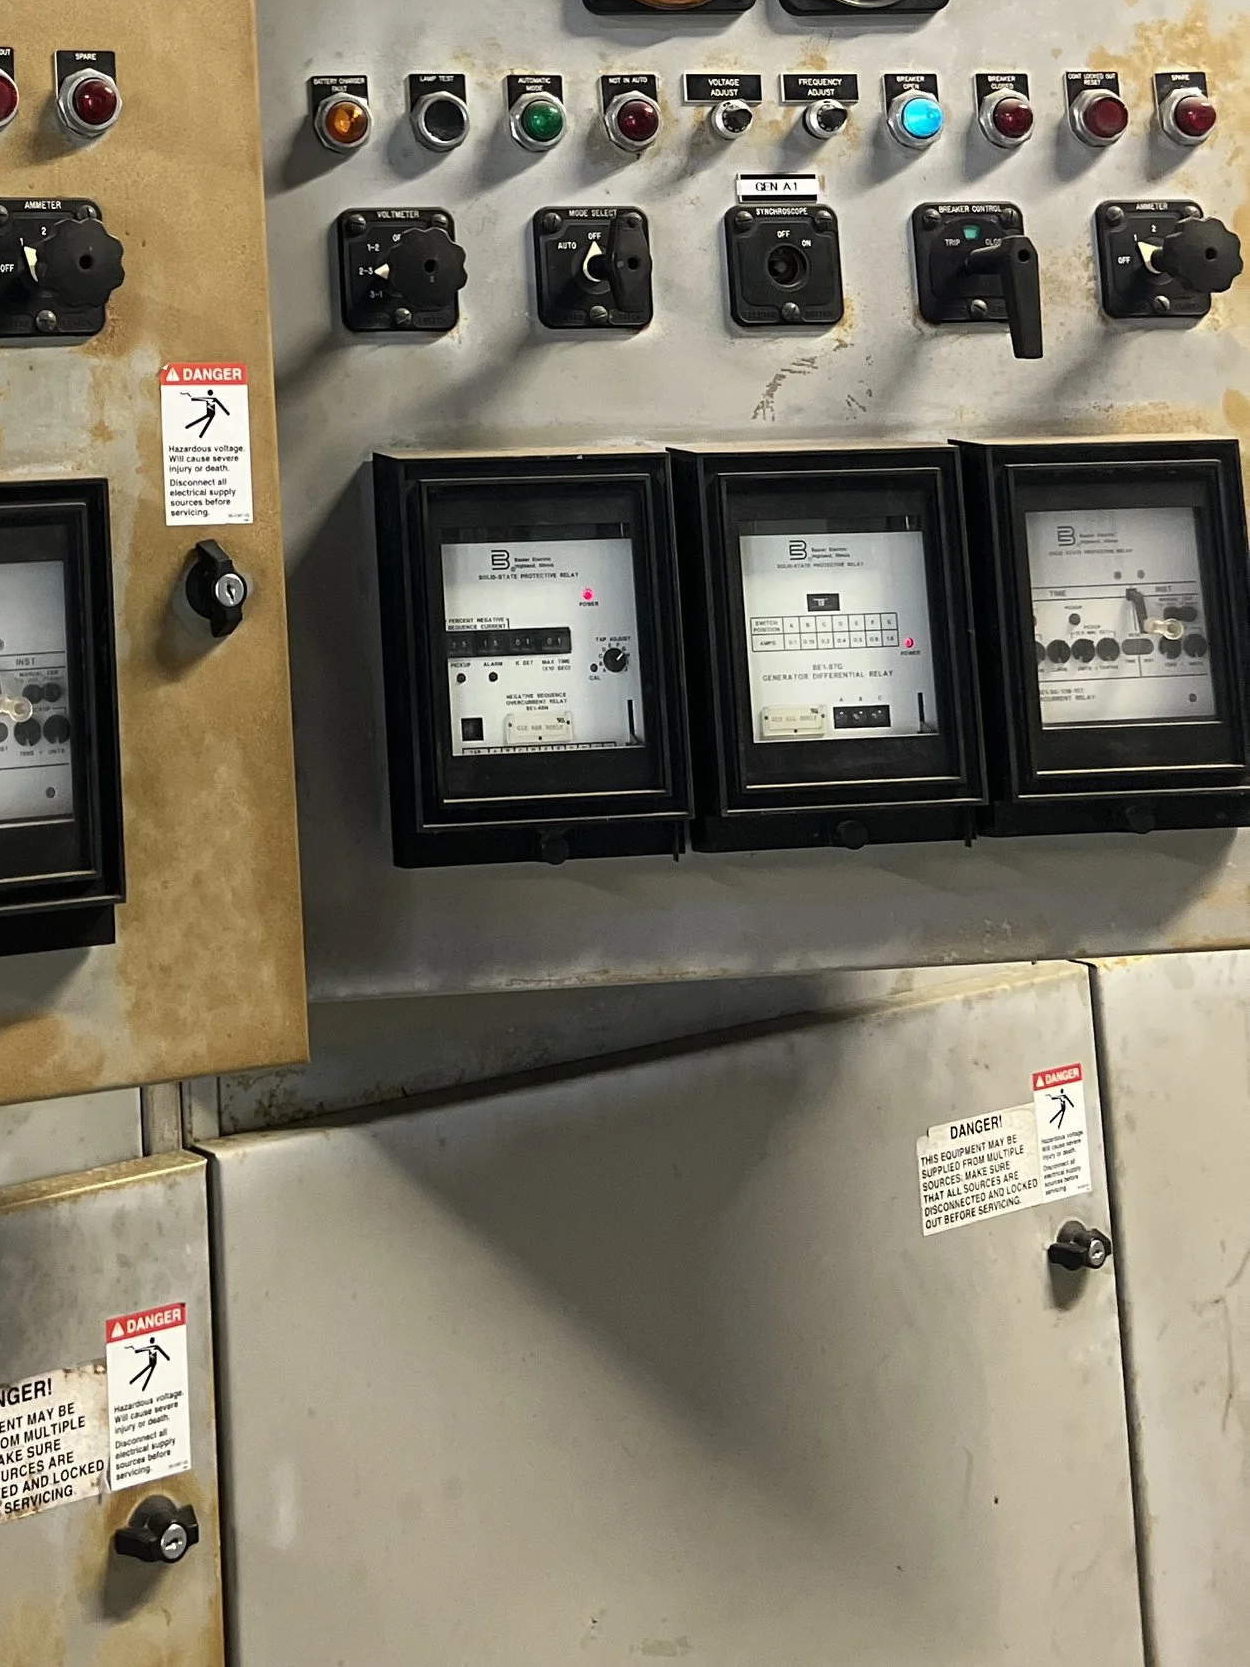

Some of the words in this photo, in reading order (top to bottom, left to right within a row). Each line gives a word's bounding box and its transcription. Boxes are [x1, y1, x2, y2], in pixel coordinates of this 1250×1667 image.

[798, 78, 842, 86] FREQUENCY
[710, 88, 738, 96] ADJUST
[807, 88, 835, 97] ADJUST
[755, 182, 778, 191] GEN
[783, 182, 797, 191] A1
[25, 201, 61, 210] AMMETER
[939, 205, 969, 213] BREAKER
[972, 205, 1001, 213] CONTROL
[377, 211, 420, 219] VOLTMETER
[568, 209, 589, 217] MODE
[592, 209, 618, 217] SELECT
[755, 208, 808, 216] SYNCHROSCOPE
[558, 241, 577, 249] AUTO
[0, 264, 14, 273] OFF
[183, 368, 242, 381] DANGER
[214, 445, 245, 453] voltage.
[209, 488, 236, 496] supply
[205, 498, 231, 506] before
[16, 658, 36, 666] INST
[951, 1115, 1003, 1140] DANGER!
[921, 1153, 939, 1166] THIS
[941, 1141, 986, 1163] EQUIPMENT
[988, 1139, 1004, 1150] MAY
[1007, 1134, 1017, 1144] BE
[922, 1161, 960, 1178] SUPPLIED
[963, 1154, 985, 1167] FROM
[987, 1145, 1024, 1162] MULTIPLE
[924, 1190, 944, 1204] THAT
[947, 1186, 962, 1196] ALL
[964, 1175, 1001, 1194] SOURCES
[1003, 1171, 1019, 1182] ARE
[925, 1193, 986, 1217] DISCONNECTED
[988, 1188, 1005, 1199] AND
[1007, 1178, 1038, 1195] LOCKED
[126, 1308, 181, 1333] DANGER
[114, 1398, 153, 1413] Hazardous
[156, 1390, 184, 1403] voltage.
[26, 1408, 54, 1426] MAY
[58, 1402, 74, 1416] BE
[24, 1416, 86, 1444] MULTIPLE
[115, 1444, 149, 1459] electrical
[152, 1437, 175, 1451] supply
[48, 1452, 74, 1469] ARE
[116, 1456, 145, 1470] sources
[148, 1449, 171, 1462] before
[22, 1475, 50, 1492] AND
[53, 1460, 105, 1484] LOCKED
